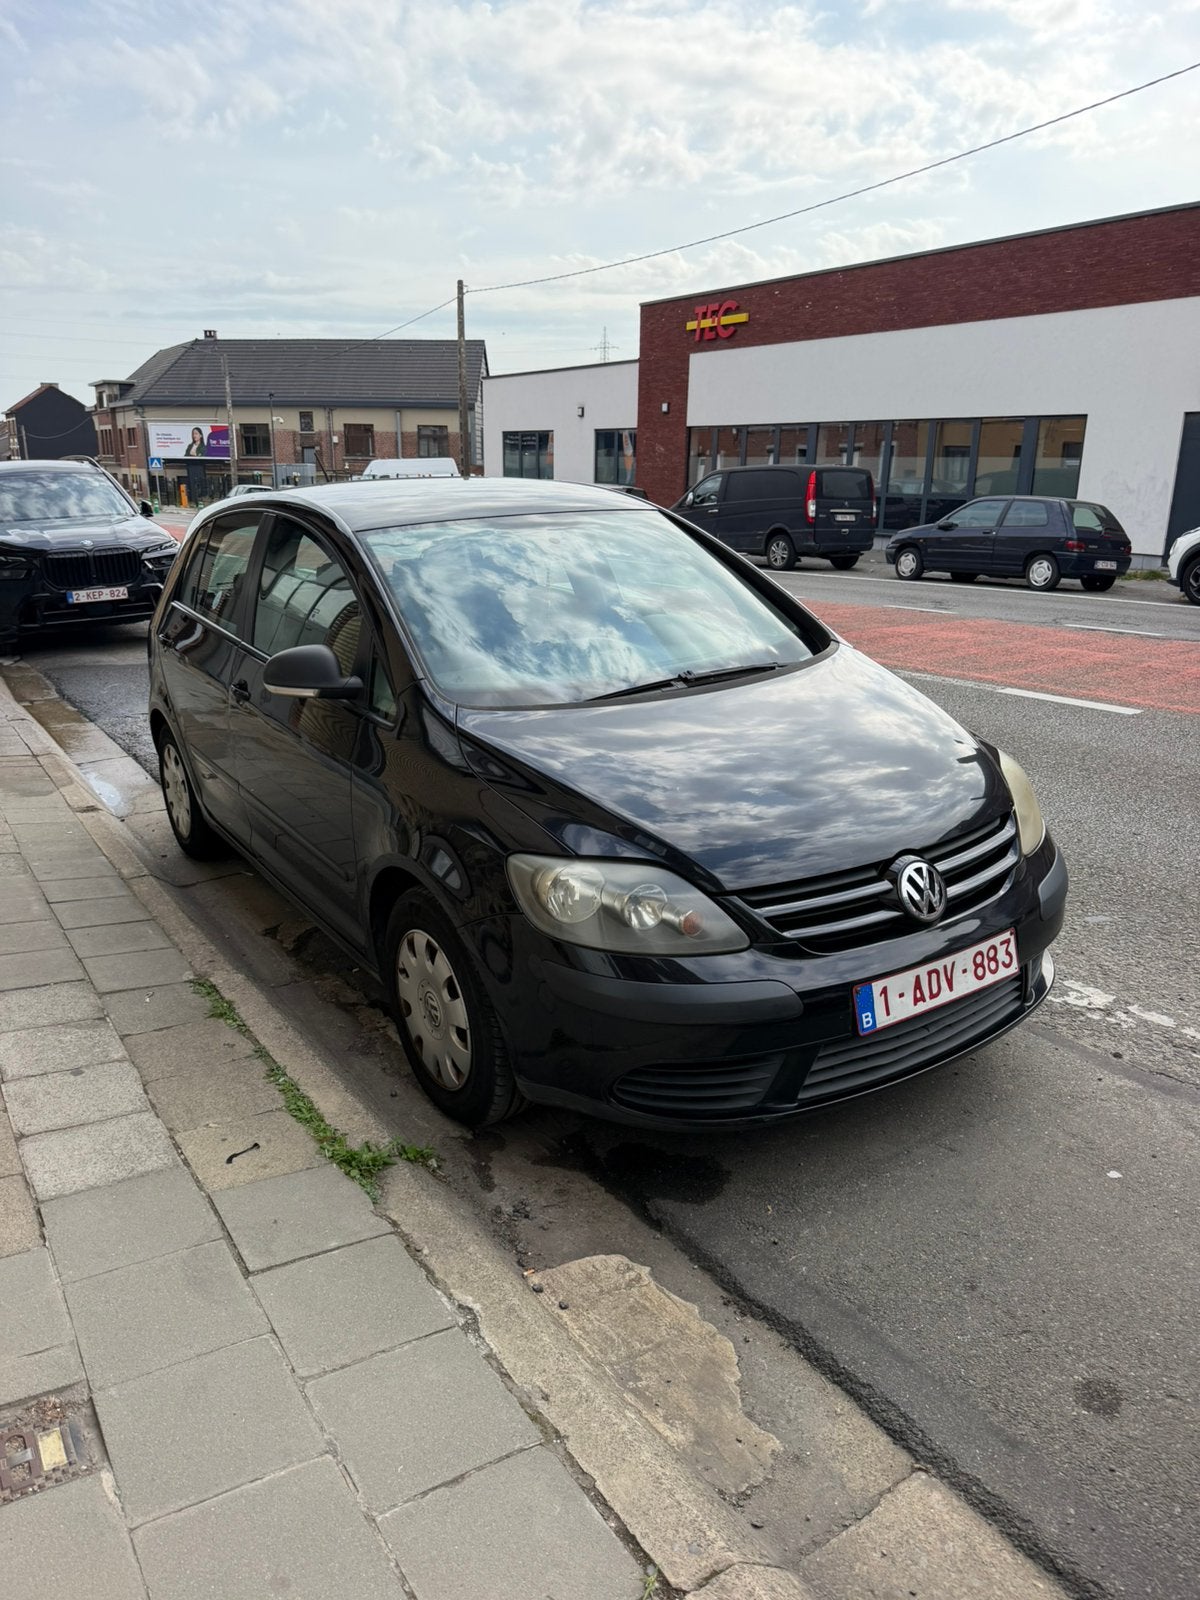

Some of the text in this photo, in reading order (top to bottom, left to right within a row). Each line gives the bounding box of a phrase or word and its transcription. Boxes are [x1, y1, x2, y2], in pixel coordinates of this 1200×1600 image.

[694, 300, 738, 341] TEC
[74, 588, 127, 602] 2-KEP-824
[879, 938, 1014, 1017] 1-ADV-883
[861, 1011, 873, 1029] B
